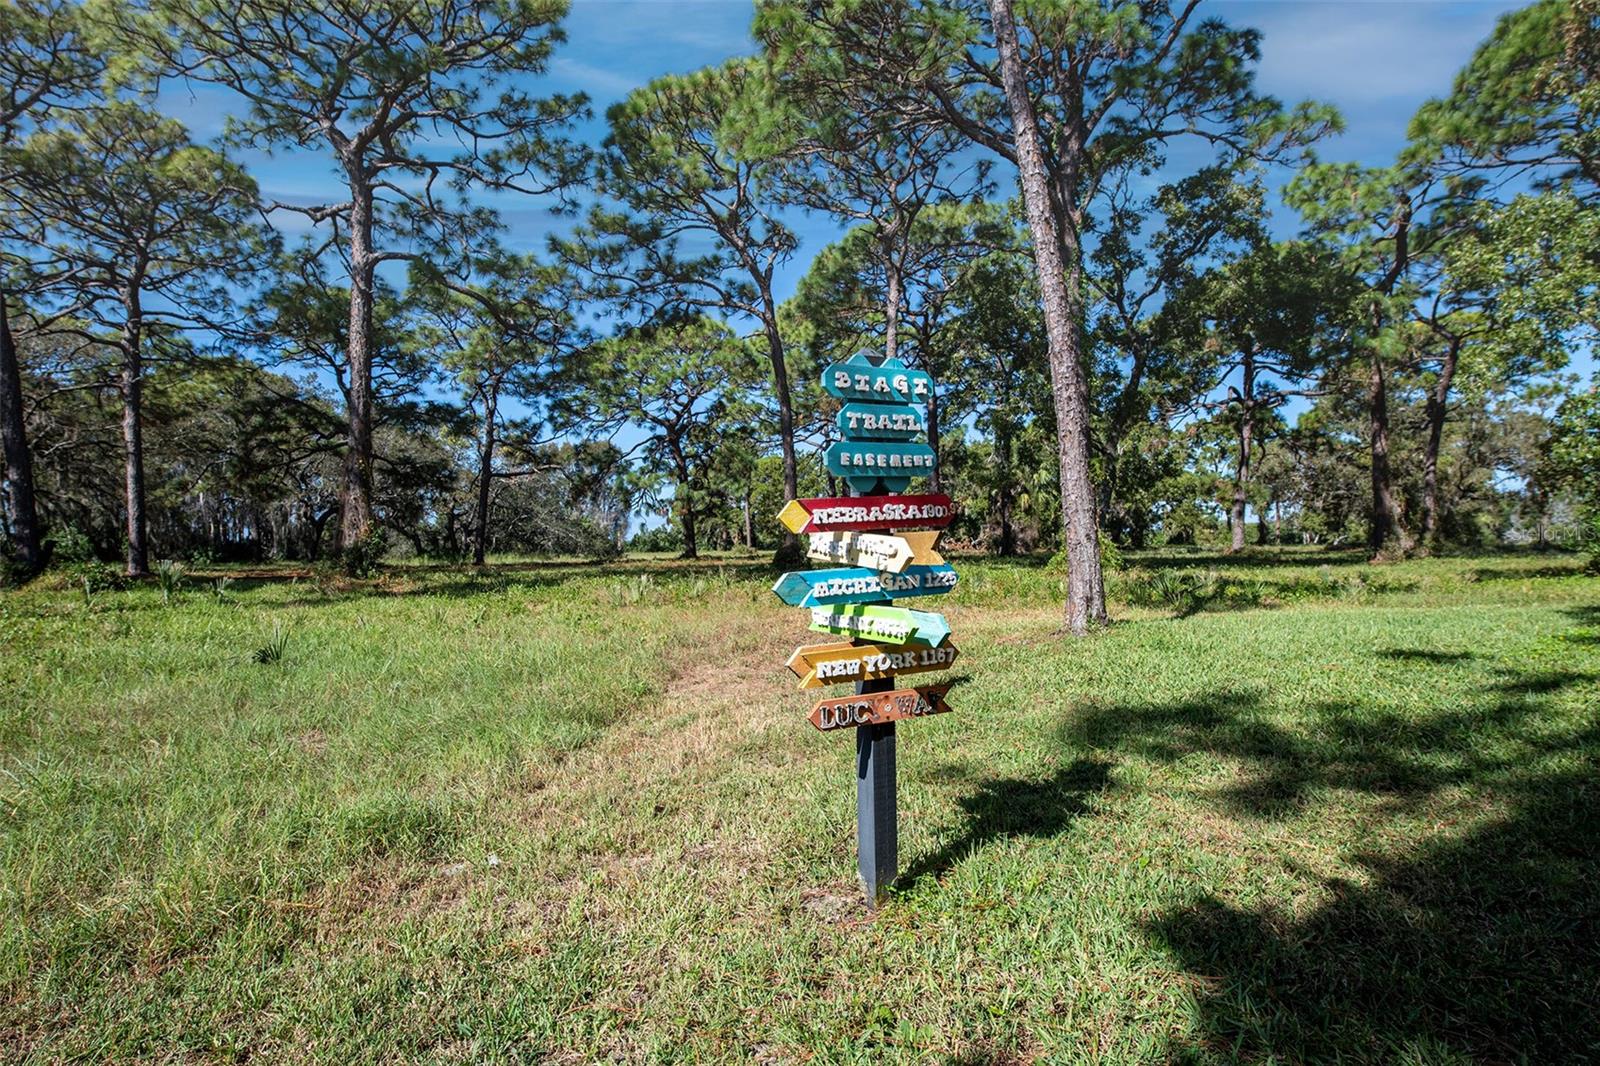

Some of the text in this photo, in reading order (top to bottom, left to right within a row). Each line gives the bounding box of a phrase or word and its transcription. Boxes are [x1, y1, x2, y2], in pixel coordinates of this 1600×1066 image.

[835, 371, 928, 394] BIAGI
[846, 411, 922, 431] TRAIL
[840, 452, 934, 468] EASEMENT
[812, 503, 923, 525] NEBRASKA
[813, 571, 957, 598] MICHIGAN 1225
[816, 649, 954, 679] NEW YORK 1167
